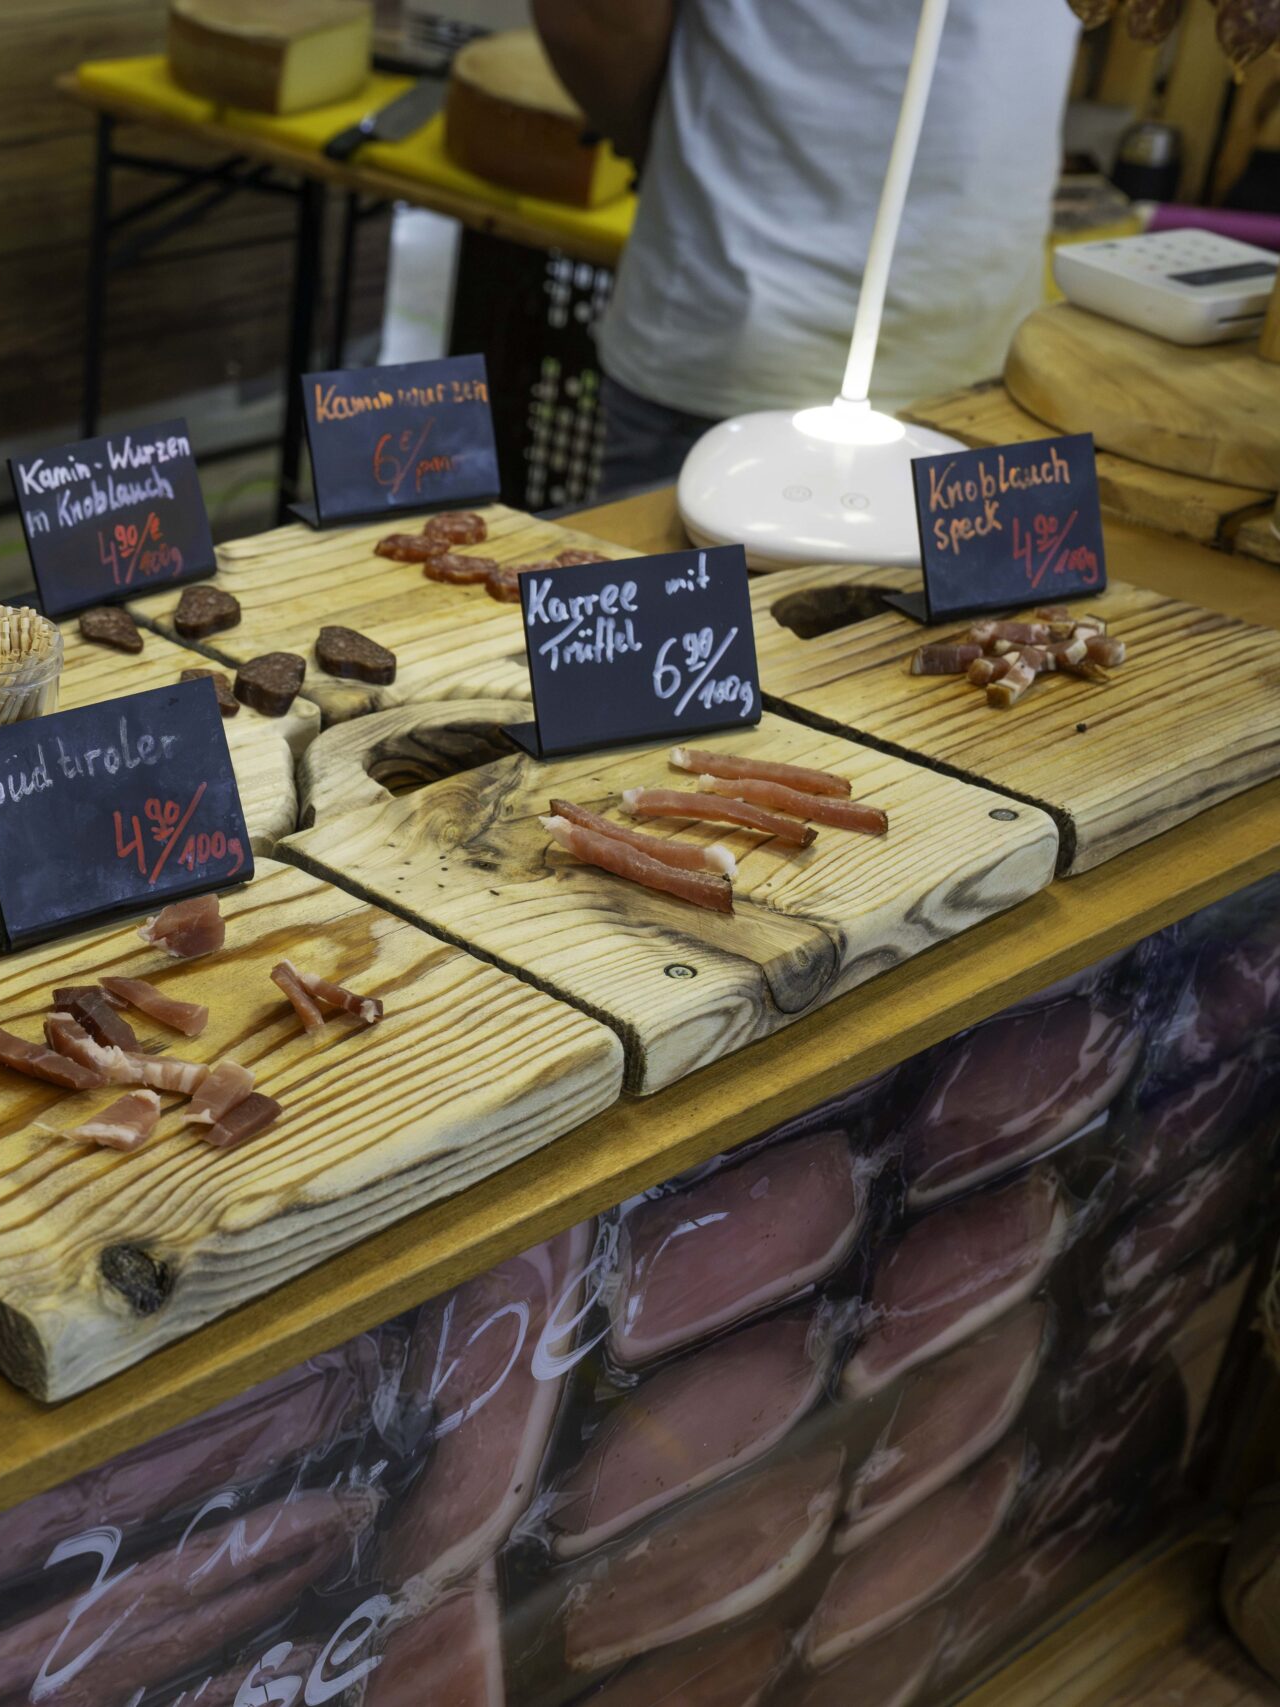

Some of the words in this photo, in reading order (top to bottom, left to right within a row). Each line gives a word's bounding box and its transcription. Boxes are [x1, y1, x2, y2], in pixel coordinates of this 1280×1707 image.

[57, 465, 175, 528] Knoblauch
[928, 446, 1071, 513] Knoblauch
[527, 577, 638, 626] Karree
[665, 552, 710, 596] mit
